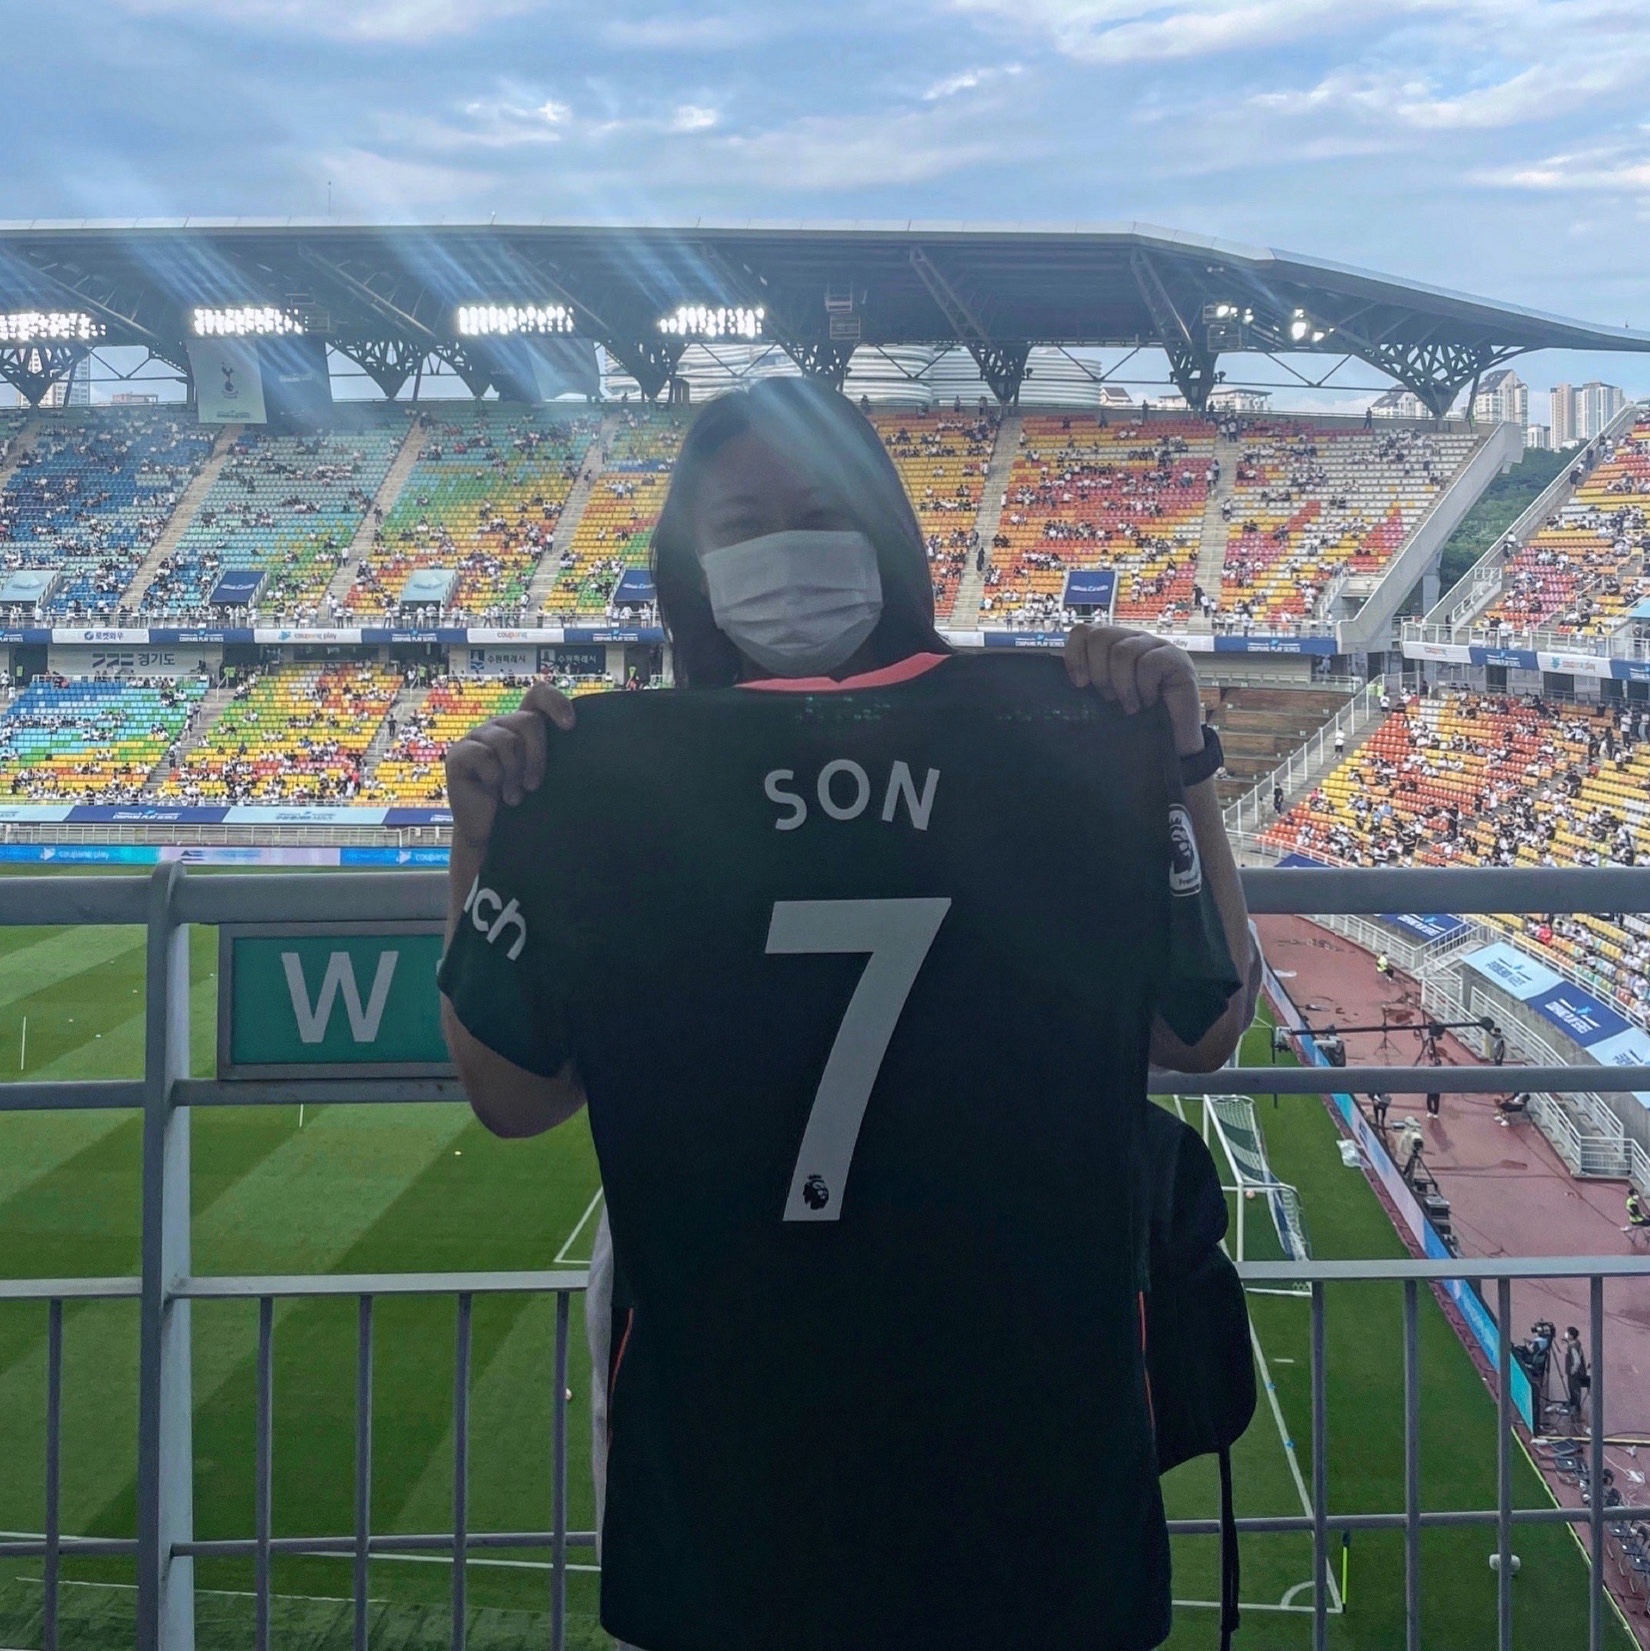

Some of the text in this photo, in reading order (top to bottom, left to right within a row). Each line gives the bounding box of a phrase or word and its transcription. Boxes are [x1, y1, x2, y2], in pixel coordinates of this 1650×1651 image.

[95, 631, 124, 641] 로켓와우
[138, 653, 175, 666] 경기도
[764, 759, 940, 831] SON
[281, 951, 399, 1043] W
[764, 897, 952, 1222] 7
